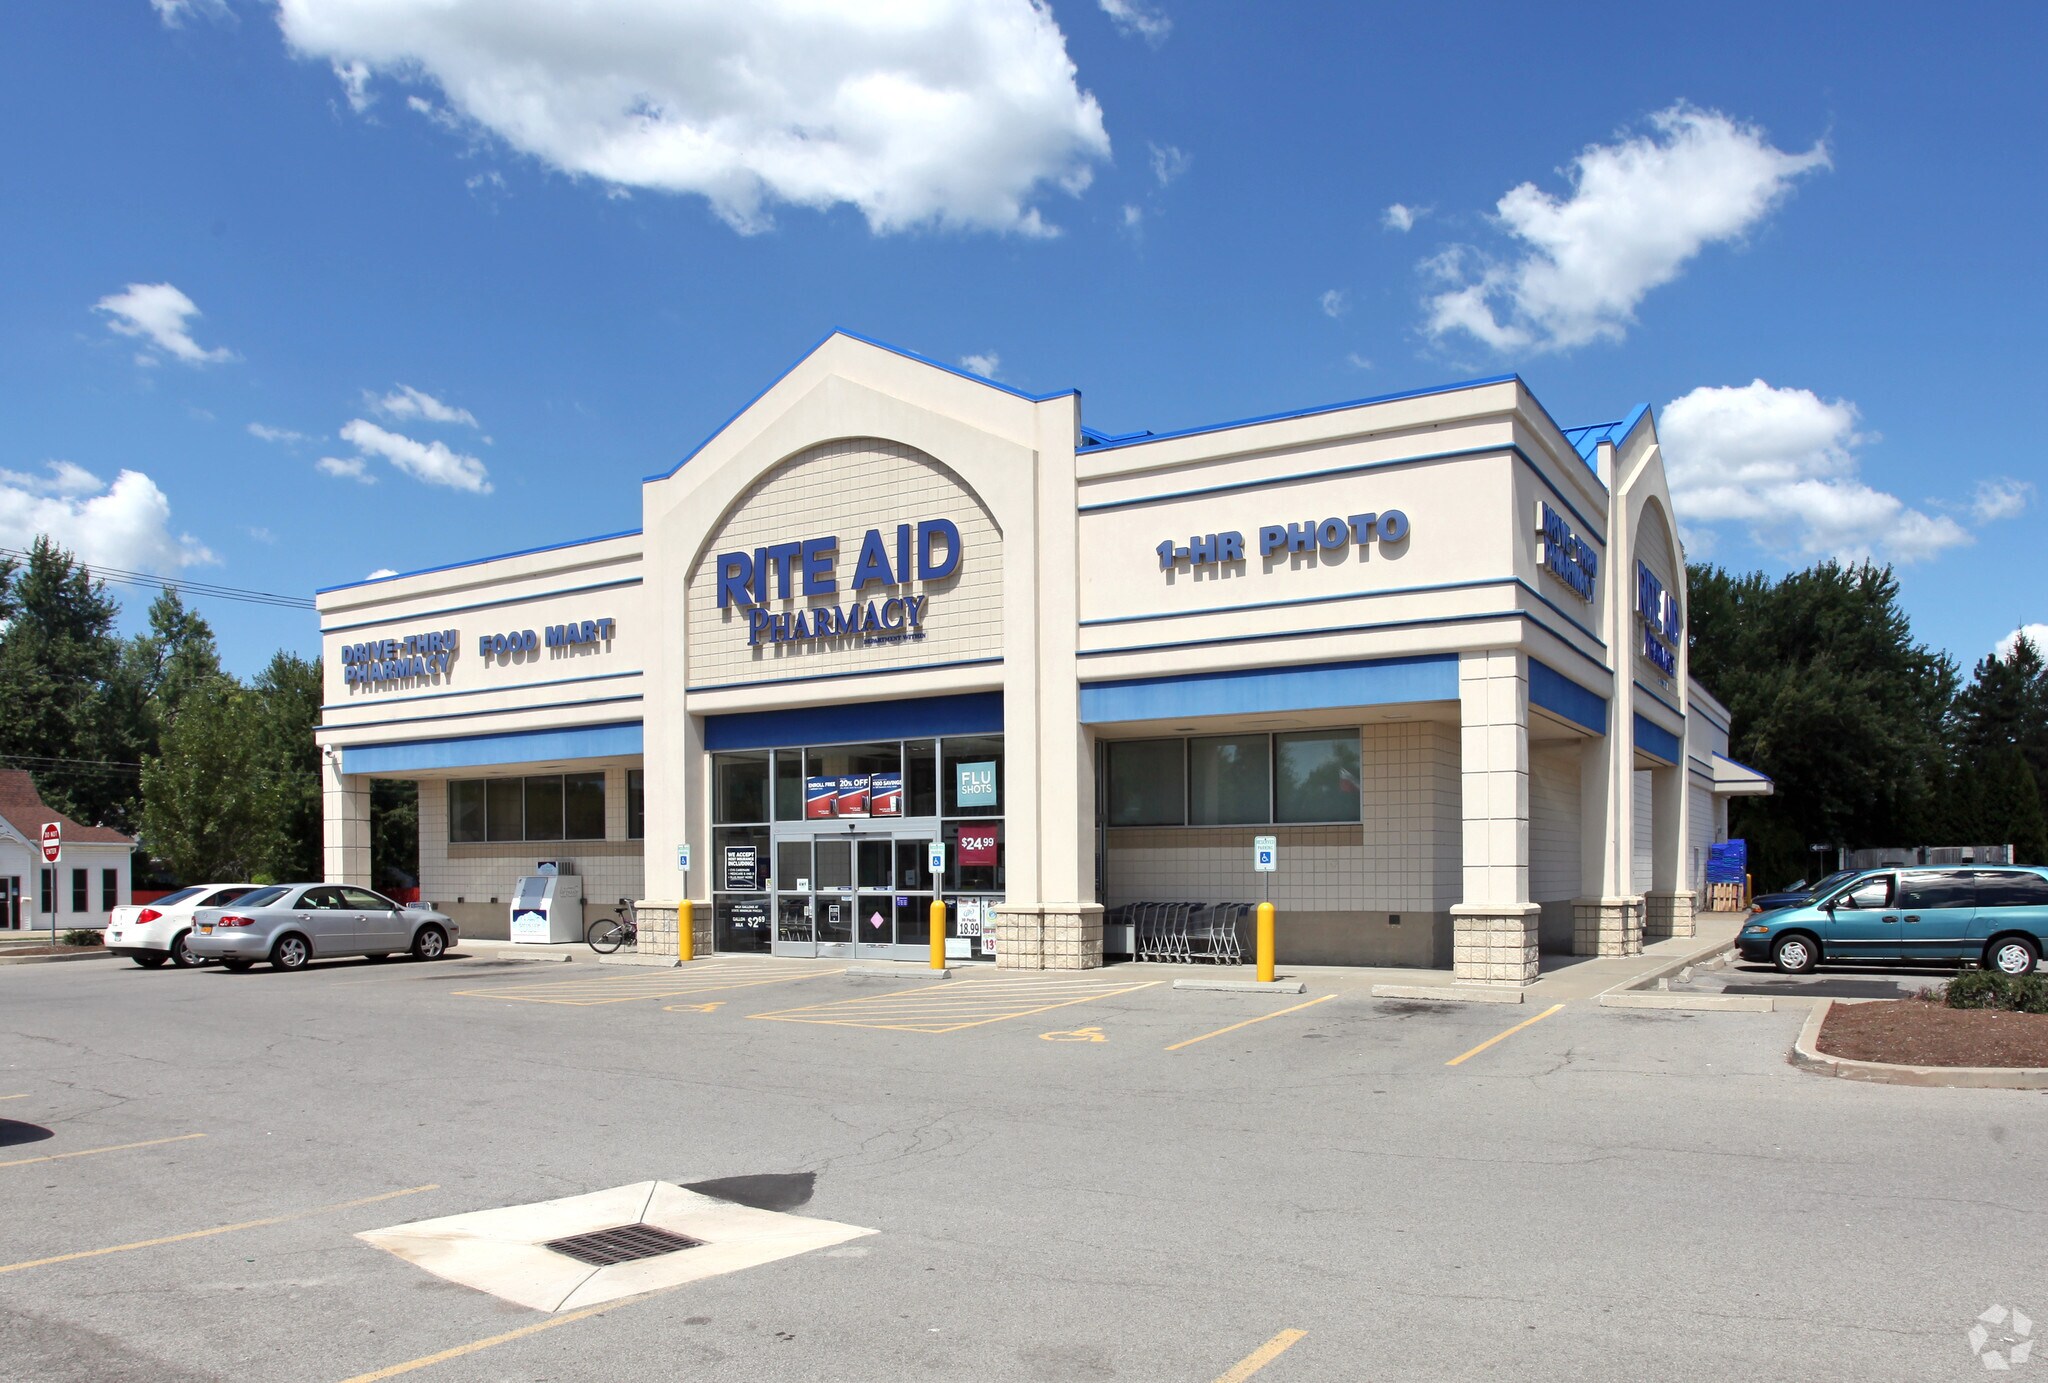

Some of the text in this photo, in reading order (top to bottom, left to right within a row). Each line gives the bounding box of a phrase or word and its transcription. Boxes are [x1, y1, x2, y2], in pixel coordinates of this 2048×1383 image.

[1156, 509, 1409, 568] 1-HR PHOTO
[716, 518, 961, 608] RITE AID
[747, 595, 926, 646] PHARMACY
[342, 629, 457, 665] DRIVE-THRU
[479, 617, 614, 657] FOOD MART
[864, 635, 902, 645] DEPARTMENT
[345, 652, 451, 685] PHARMACY
[839, 779, 853, 787] 20%
[853, 778, 869, 787] OFF
[961, 784, 992, 794] SHOTS
[962, 771, 990, 784] FLU
[961, 837, 994, 850] $24.99
[959, 922, 979, 935] 18.99
